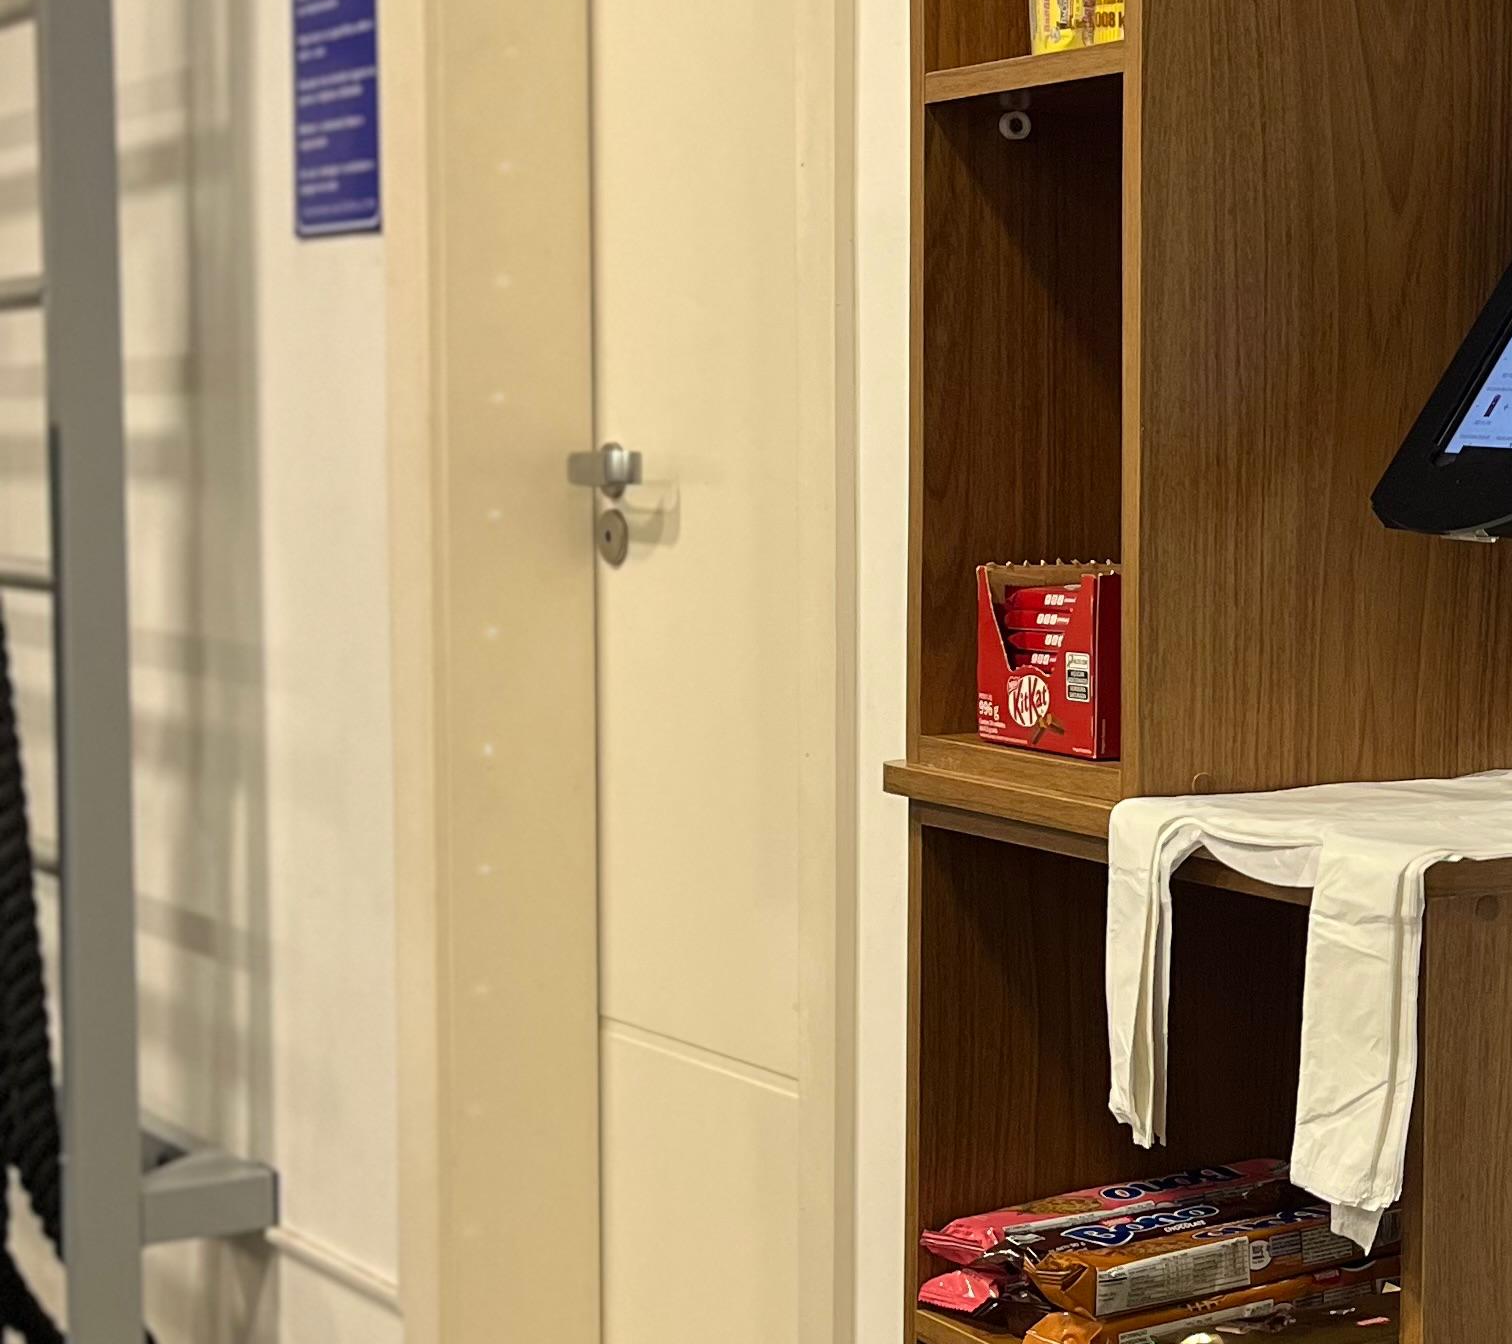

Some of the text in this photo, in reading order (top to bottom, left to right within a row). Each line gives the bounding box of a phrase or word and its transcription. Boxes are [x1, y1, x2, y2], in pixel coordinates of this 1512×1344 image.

[1013, 676, 1047, 726] KitKat
[1060, 1205, 1221, 1248] Bono
[1163, 1219, 1207, 1234] CHOCOLATE
